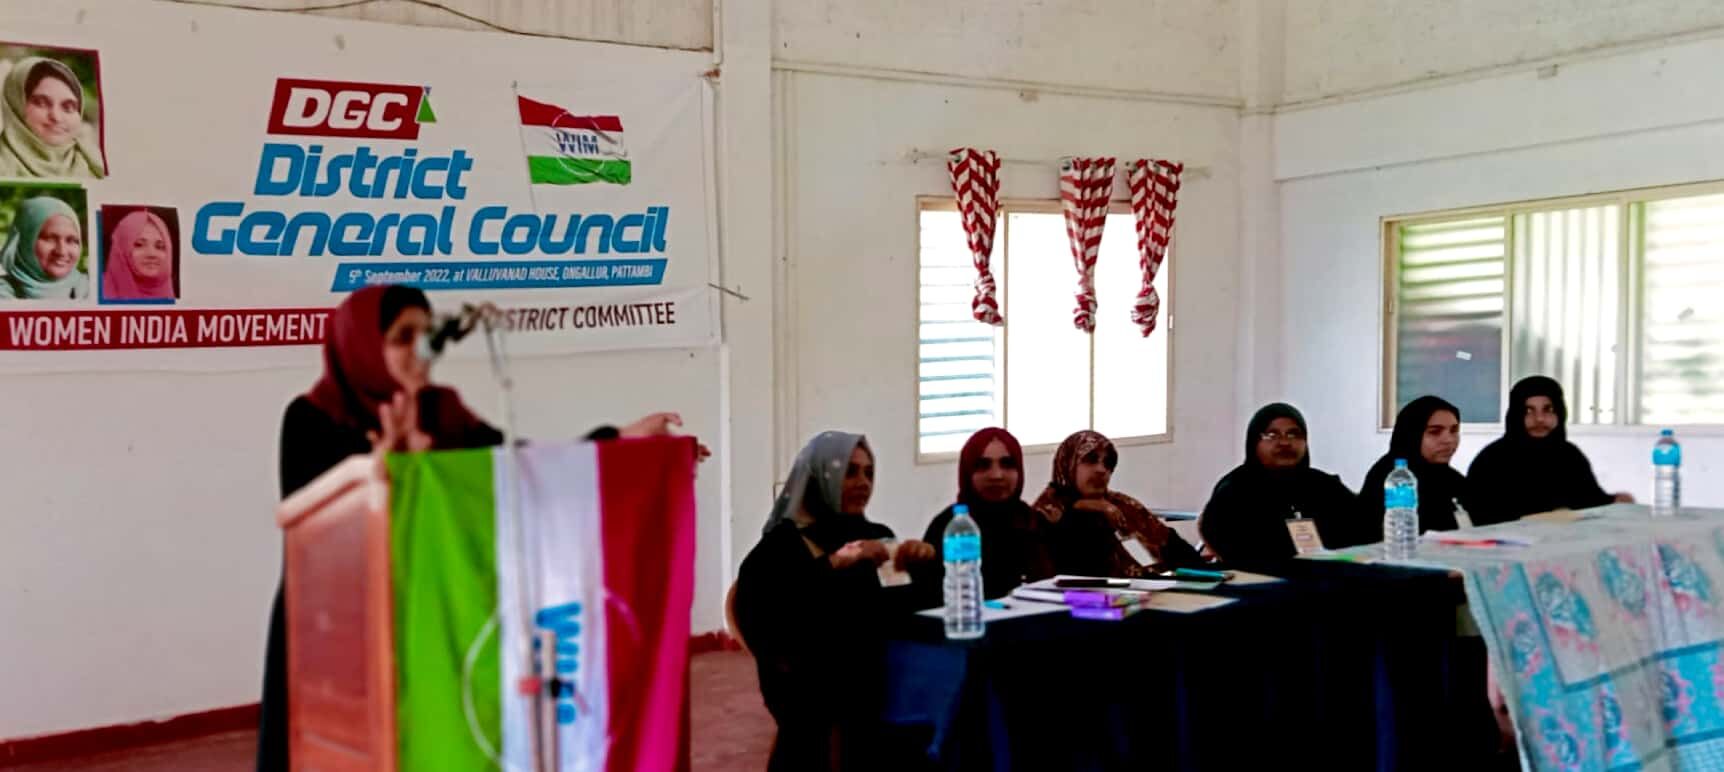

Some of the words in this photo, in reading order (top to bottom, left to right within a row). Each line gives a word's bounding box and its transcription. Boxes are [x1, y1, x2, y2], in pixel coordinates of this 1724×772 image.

[282, 86, 409, 132] DGC
[556, 132, 599, 155] WIM
[254, 142, 473, 200] District
[191, 201, 457, 257] General
[468, 206, 670, 255] Council
[365, 268, 422, 286] September
[453, 270, 465, 282] at
[466, 266, 528, 282] VALLUVANAD
[528, 266, 560, 281] HOUSE,
[611, 264, 654, 279] PATTAMBI
[8, 316, 112, 346] WOMEN
[119, 314, 189, 345] INDIA
[198, 312, 329, 343] MOVEMENT
[494, 307, 569, 333] STRICT
[572, 302, 677, 329] COMMITTEE
